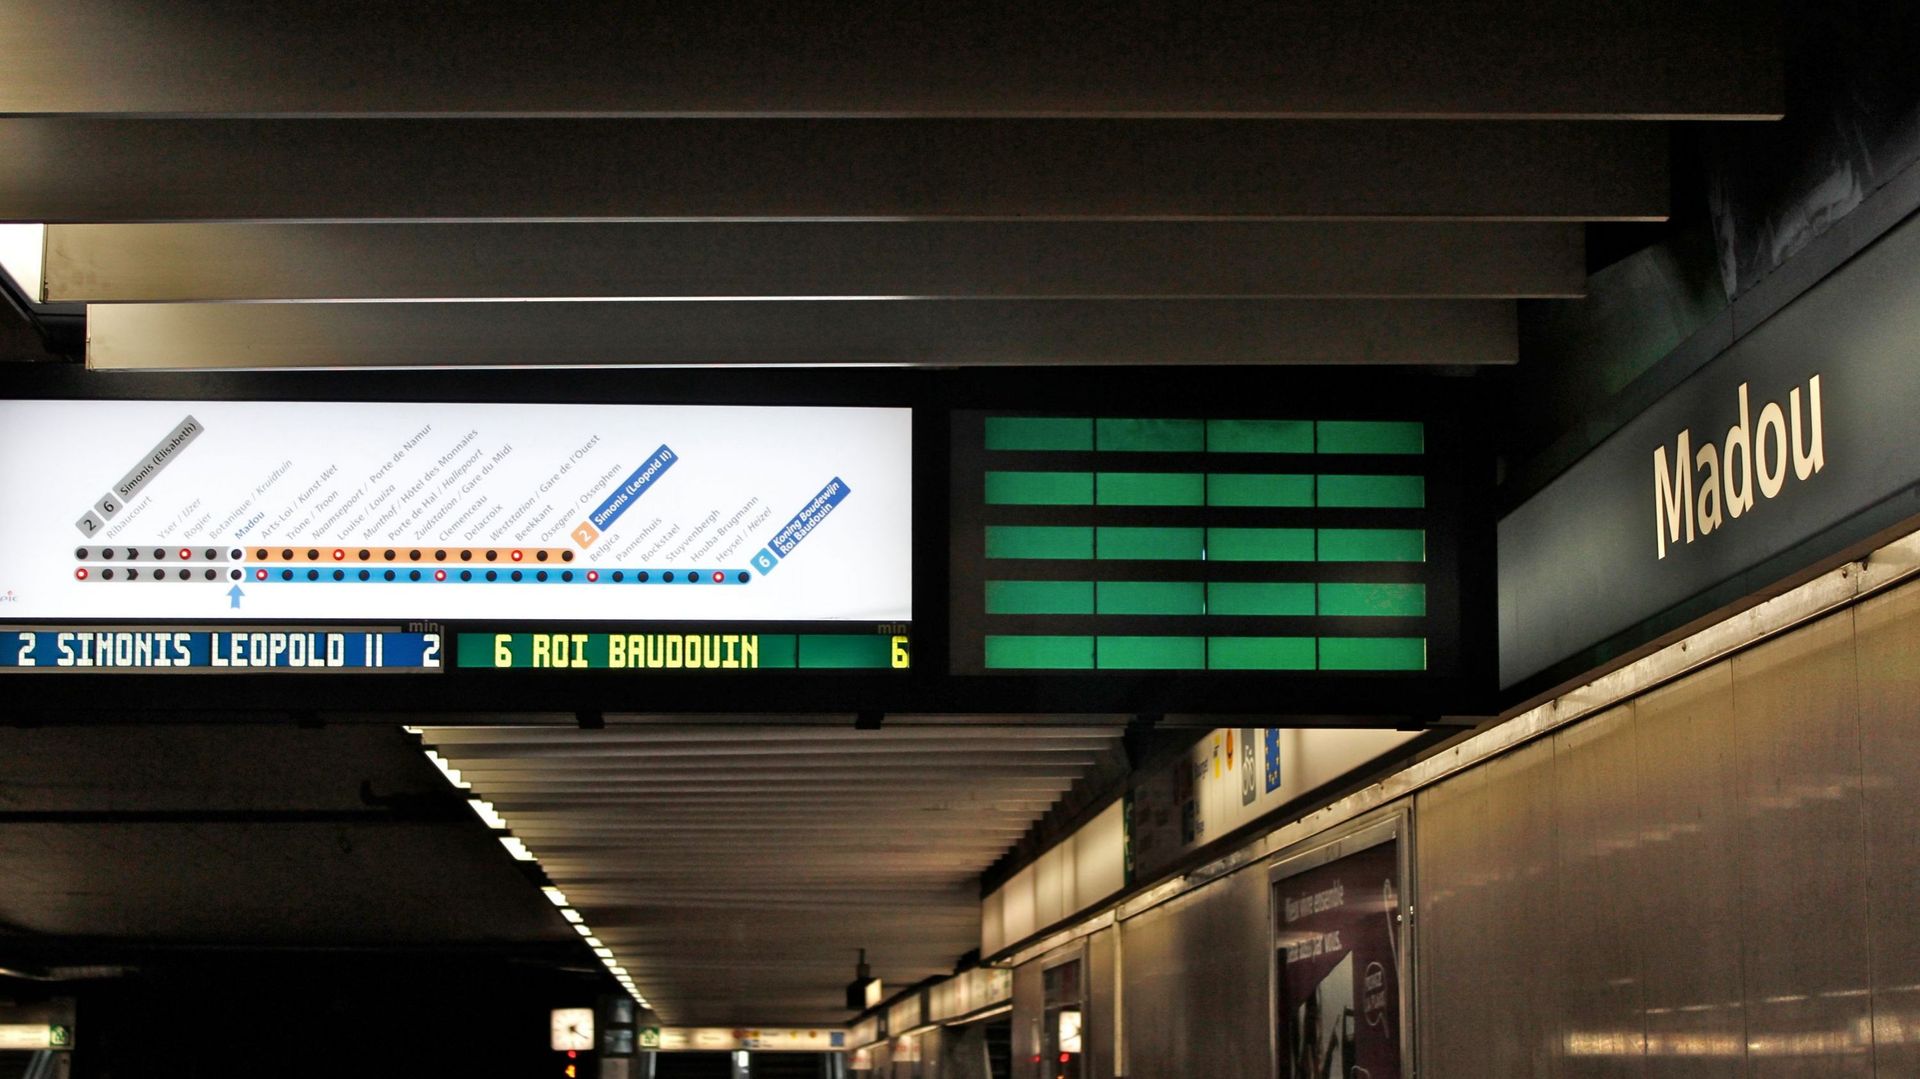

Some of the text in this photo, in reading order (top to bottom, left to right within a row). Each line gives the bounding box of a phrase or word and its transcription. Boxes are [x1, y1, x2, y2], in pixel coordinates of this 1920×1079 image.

[84, 422, 197, 531] 2 6 Simonis (Elisabeth)
[297, 464, 338, 504] Kunst-Wet
[312, 488, 365, 540] Naamsepoort
[369, 461, 394, 484] Porte
[403, 423, 432, 452] Namur
[363, 505, 398, 541] Munthof
[424, 467, 440, 482] des
[438, 429, 478, 468] Monnaies
[1653, 374, 1824, 560] Madou
[209, 498, 252, 540] Botanique
[255, 459, 293, 496] Kruidtuin
[315, 490, 339, 513] Troon
[337, 514, 365, 541] Louise
[369, 484, 396, 511] Louiza
[388, 518, 412, 541] Porte
[411, 507, 424, 519] de
[422, 492, 438, 508] Hal
[442, 448, 484, 490] Hallepoort
[414, 497, 458, 541] Zuidstation
[461, 473, 483, 494] Gare
[482, 463, 494, 475] du
[492, 443, 513, 465] Midi
[489, 497, 536, 541] Weststation
[539, 472, 561, 493] Gare
[559, 462, 571, 475] de
[541, 508, 576, 542] Ossegem
[579, 463, 622, 504] Osseghem
[594, 492, 628, 525] Simonis
[625, 459, 662, 496] (Leopold
[773, 482, 840, 548] Koning Boudewijn
[106, 495, 153, 539] Ribaucourt
[157, 521, 177, 539] Yser
[184, 512, 212, 540] Rogier
[234, 511, 265, 540] Madou
[439, 495, 488, 542] Clemenceau
[464, 504, 504, 541] Delacroix
[514, 504, 554, 542] Beekkant
[578, 530, 592, 542] 2
[615, 517, 662, 562] Pannenhuis
[666, 508, 721, 562] Stuyvenbergh
[690, 496, 759, 562] Houba-Brugmann
[716, 536, 742, 563] Heysel
[748, 506, 772, 533] Heizel
[780, 503, 833, 555] Roi Baudouin
[589, 533, 620, 562] Belgica
[641, 523, 680, 562] Bockstael
[759, 556, 770, 567] 6
[409, 620, 438, 632] min
[877, 622, 907, 634] min
[18, 632, 36, 667] 2
[56, 632, 191, 667] SIMONIS
[210, 632, 345, 667] LEOPOLD
[422, 633, 440, 668] 2
[494, 633, 910, 668] 6 ROI BAUDOUIN 6
